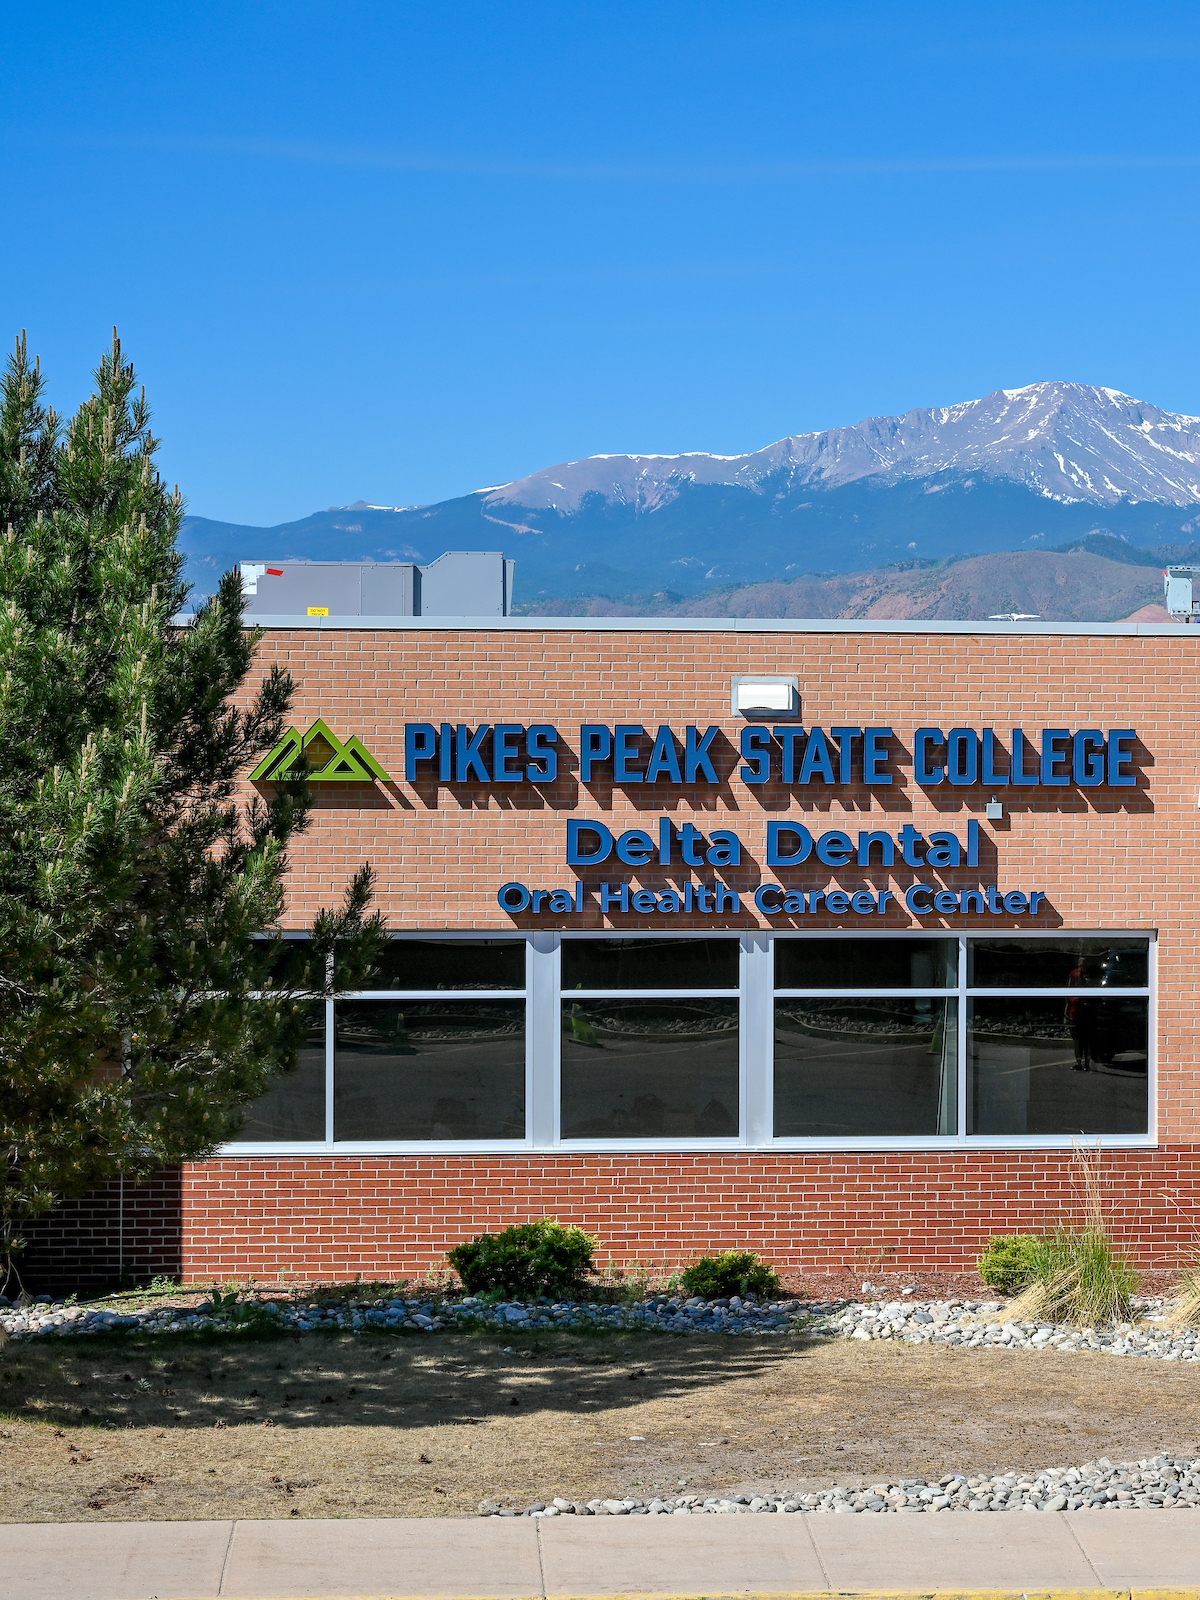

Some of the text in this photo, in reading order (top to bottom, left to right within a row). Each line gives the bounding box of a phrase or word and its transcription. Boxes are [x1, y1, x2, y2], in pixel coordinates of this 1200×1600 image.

[405, 723, 1137, 786] PIKES PEAK STATE COLLEGE
[566, 817, 980, 867] Delta Dental
[497, 881, 1046, 914] Oral Health Career Center
